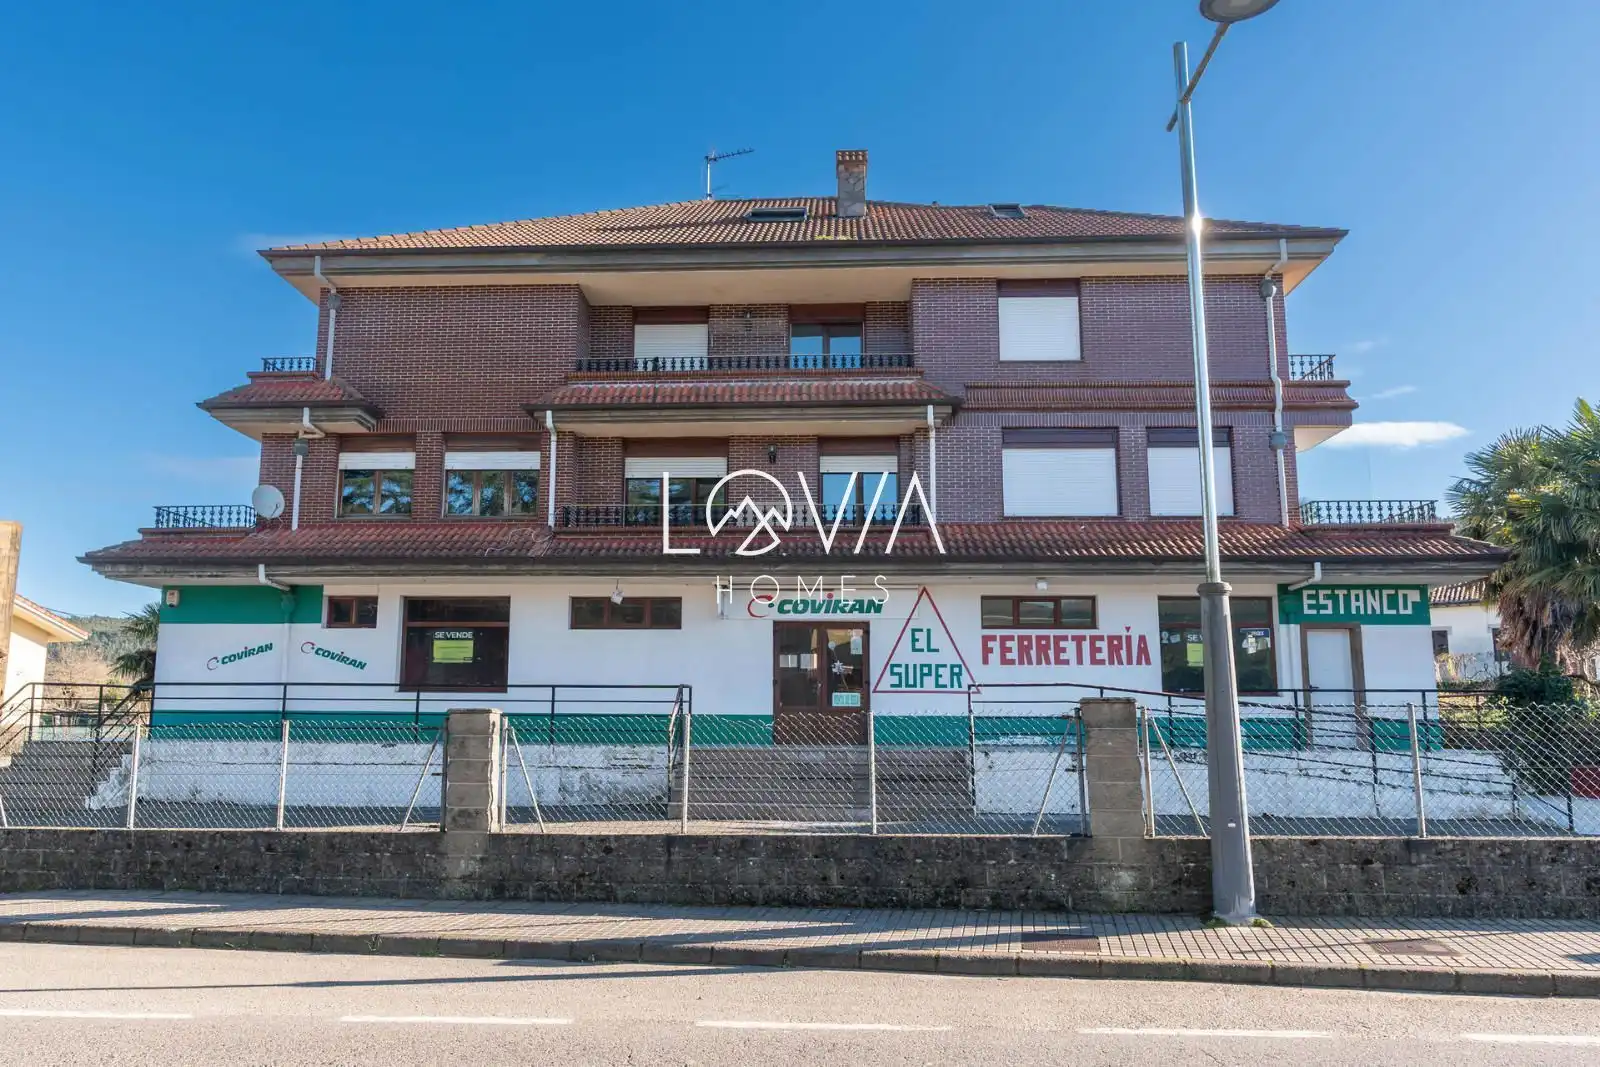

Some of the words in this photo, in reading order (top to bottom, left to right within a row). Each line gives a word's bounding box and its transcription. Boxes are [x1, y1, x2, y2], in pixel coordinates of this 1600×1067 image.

[1302, 589, 1421, 615] ESTANCO
[434, 631, 445, 639] SE
[446, 631, 473, 639] VENDE
[910, 628, 940, 653] EL
[1187, 634, 1199, 642] SE
[889, 663, 963, 689] SUPER
